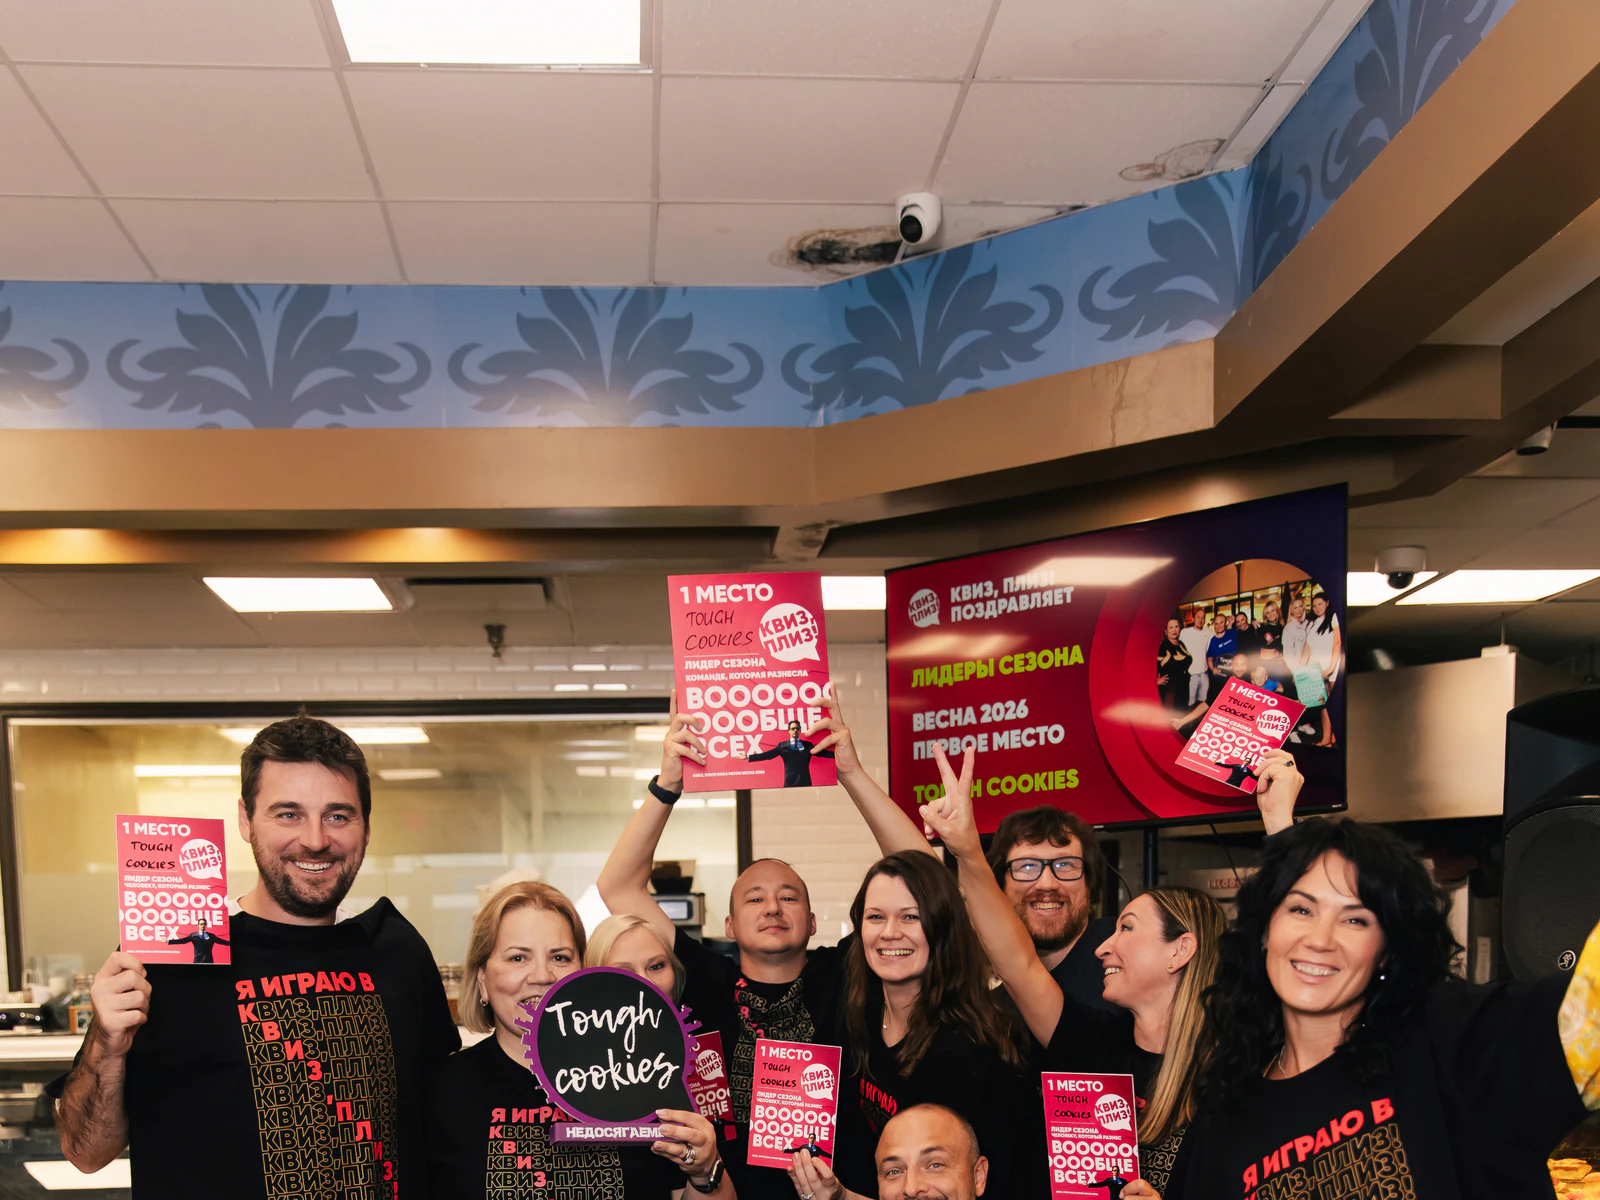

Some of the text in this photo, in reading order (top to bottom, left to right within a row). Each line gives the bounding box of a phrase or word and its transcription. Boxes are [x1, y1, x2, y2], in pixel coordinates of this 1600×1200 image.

[680, 583, 773, 604] 1 МЕСТО
[951, 570, 1055, 603] КВИЗ, ПЛИЗ!
[909, 592, 939, 613] КВИЗ,
[951, 586, 1074, 622] ПОЗДРАВЛЯЕТ
[686, 609, 735, 627] TOUGH
[910, 602, 940, 623] ПЛИЗ!
[760, 610, 816, 638] КВИЗ,
[763, 624, 819, 654] ПЛИЗ!
[684, 657, 766, 671] ЛИДЕР СЕЗОНА
[911, 645, 1084, 688] ЛИДЕРЫ СЕЗОНА
[685, 669, 808, 682] КОМАНДЕ, КОТОРАЯ РАЗНЕСЛА
[1229, 682, 1278, 707] 1 МЕСТО
[1229, 696, 1255, 711] TOUGH
[682, 706, 822, 735] ОООБЩЕ
[912, 699, 1029, 732] ВЕСНА 2026
[1210, 713, 1252, 732] ЛИДЕР СЕЗОНА
[913, 724, 1065, 760] ПЕРВОЕ МЕСТО
[1188, 742, 1230, 765] ВСЕХ
[913, 769, 1079, 803] TOH COOKIES
[122, 822, 191, 837] 1 МЕСТО
[131, 841, 173, 852] TOUGH
[180, 844, 220, 861] КВИЗ,
[182, 855, 222, 873] ПЛИЗ!
[124, 875, 150, 883] ЛИДЕР
[124, 882, 157, 890] ЧЕЛОВЕКУ,
[124, 890, 229, 909] ВООООО
[125, 925, 180, 941] ВСЕХ
[235, 971, 375, 1000] Я ИГРАЮ В
[544, 991, 662, 1053] Tough
[761, 1046, 813, 1061] 1 МЕСТО
[555, 1048, 680, 1094] cookies
[762, 1062, 791, 1073] TOUGH
[802, 1069, 833, 1082] КВИЗ,
[802, 1079, 834, 1092] ПЛИЗ!
[1047, 1079, 1104, 1092] 1 МЕСТО
[757, 1091, 777, 1099] ЛИДЕР
[1054, 1095, 1088, 1105] TOUGH
[491, 1106, 575, 1123] Я ИГРА
[755, 1104, 837, 1127] ВООООО
[1095, 1099, 1129, 1115] КВИЗ,
[1097, 1108, 1131, 1125] ПЛИЗ!
[749, 1119, 829, 1142] ОООБЩЕ
[1051, 1126, 1099, 1134] ЛИДЕР СЕЗОНА
[752, 1134, 794, 1150] ВСЕХ
[1051, 1140, 1138, 1158] ВООООО
[1243, 1098, 1395, 1193] Я ИГРАЮ В
[1048, 1155, 1133, 1174] ОООБЩЕ
[1054, 1170, 1098, 1184] ВСЕХ
